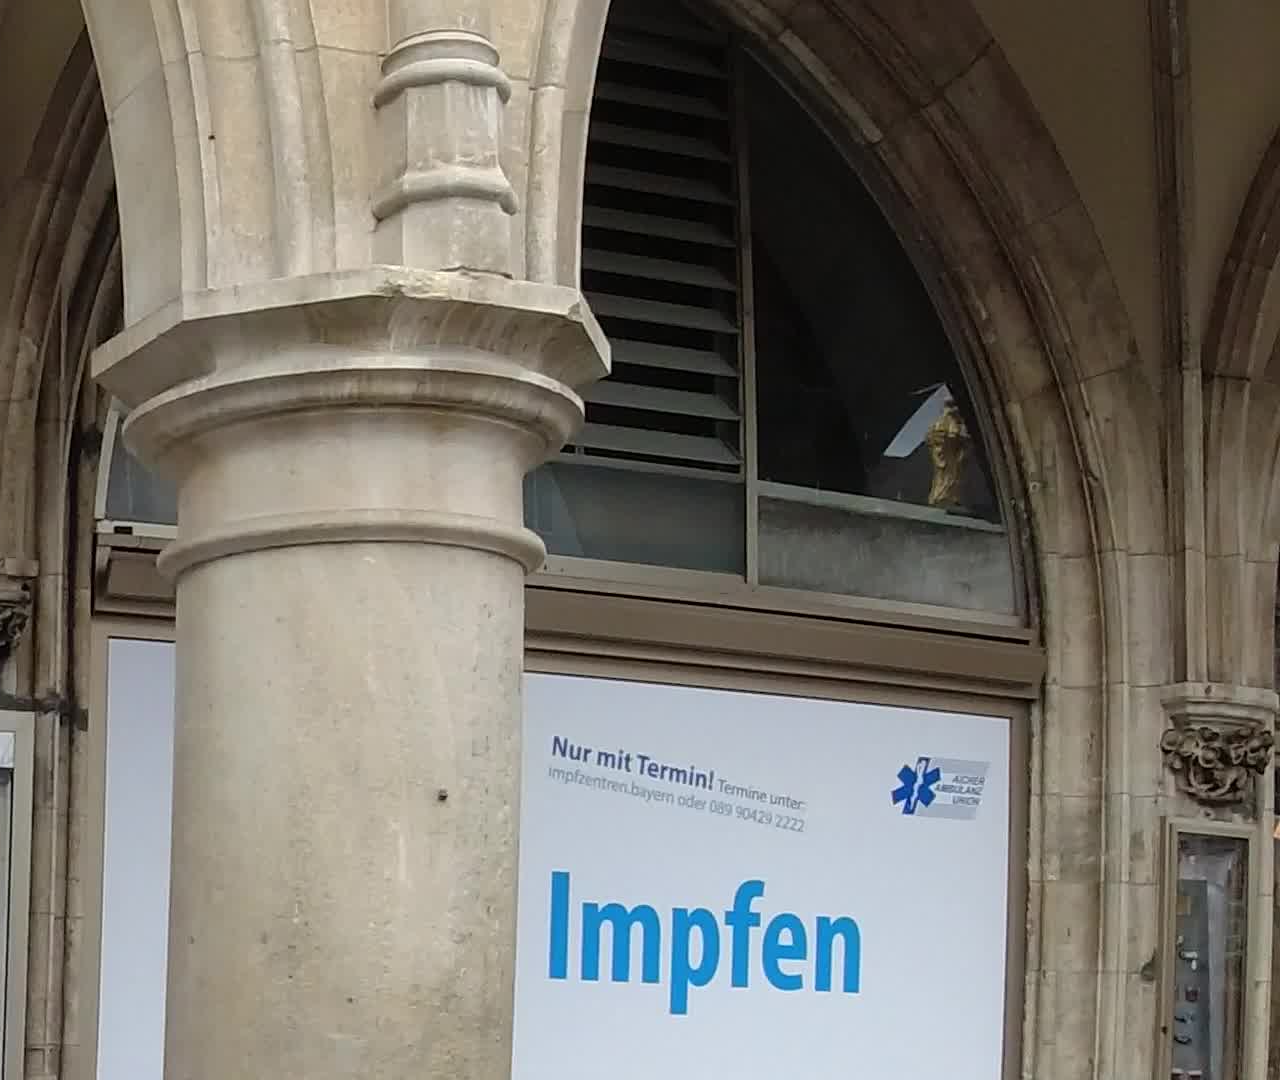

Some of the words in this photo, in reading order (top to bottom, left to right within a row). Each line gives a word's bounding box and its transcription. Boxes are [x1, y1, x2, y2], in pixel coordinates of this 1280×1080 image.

[551, 735, 592, 763] Nur
[596, 749, 633, 773] mit
[637, 753, 715, 790] Termin!
[718, 778, 768, 803] Termine
[677, 792, 707, 810] oder
[775, 814, 805, 833] 2222
[548, 870, 862, 1015] Impfen
